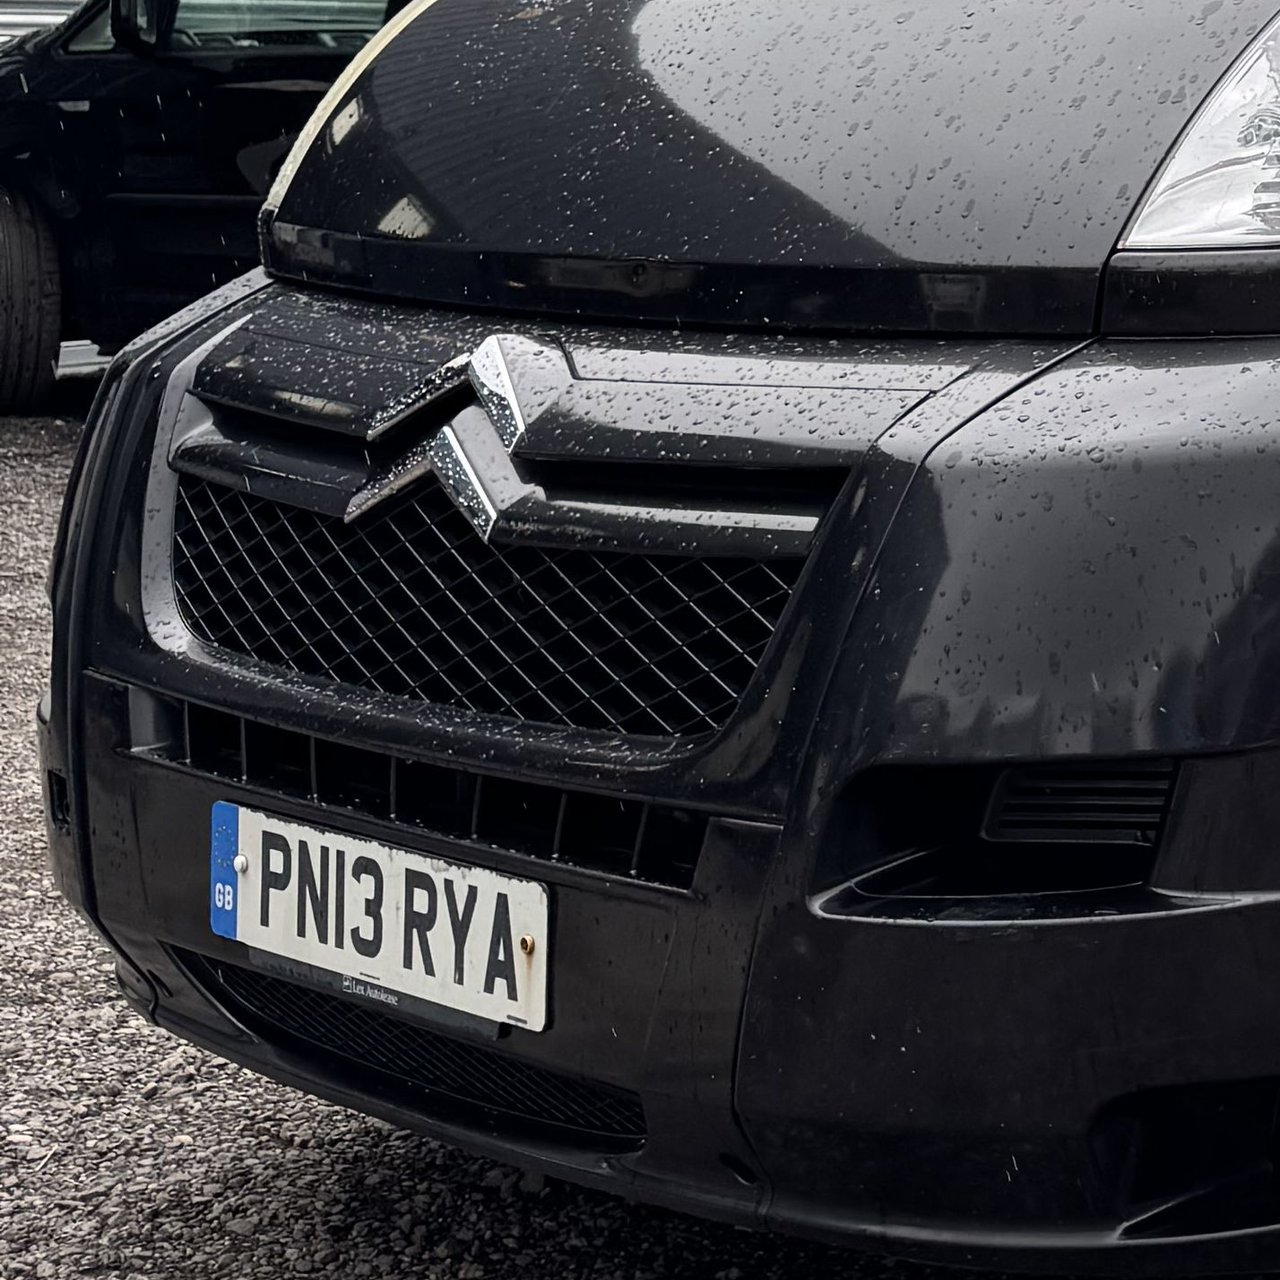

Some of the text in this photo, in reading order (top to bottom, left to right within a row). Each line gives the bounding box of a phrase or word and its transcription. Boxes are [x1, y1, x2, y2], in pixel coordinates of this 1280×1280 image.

[215, 882, 234, 910] GB
[260, 830, 518, 1001] PN13 RYA
